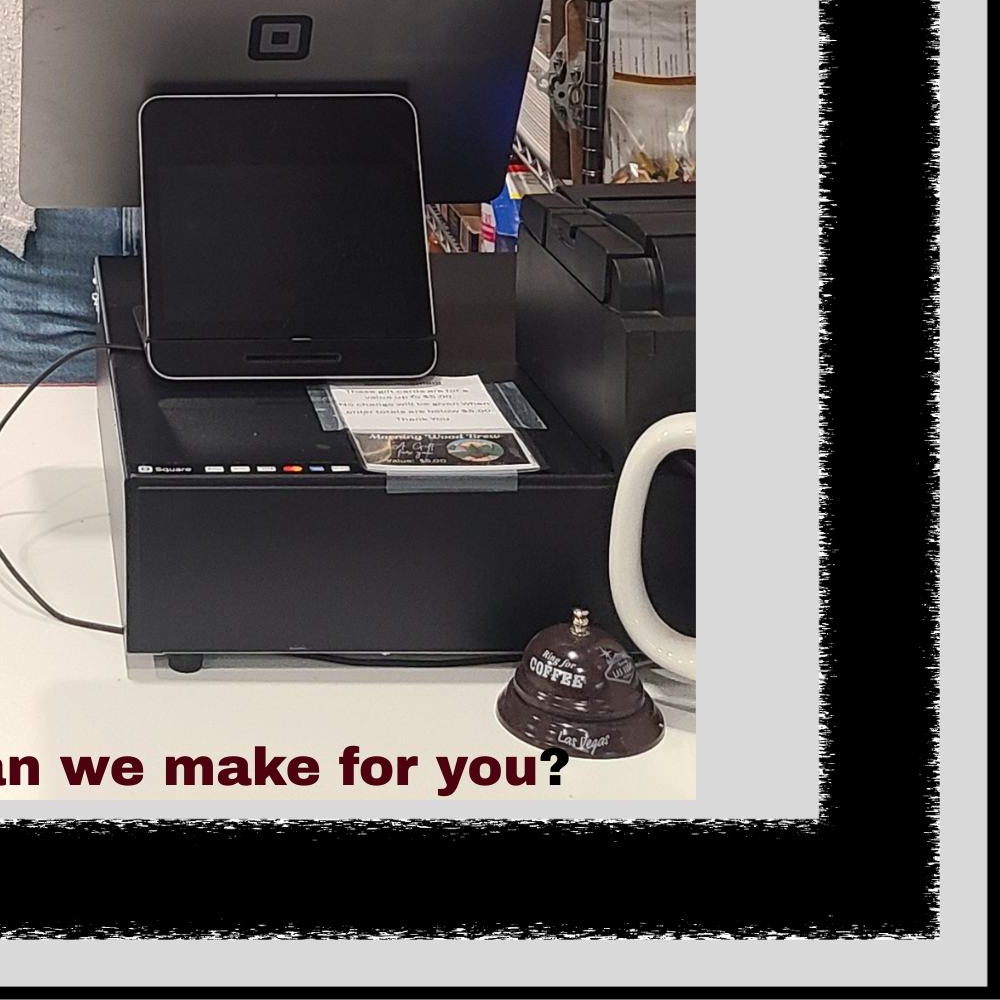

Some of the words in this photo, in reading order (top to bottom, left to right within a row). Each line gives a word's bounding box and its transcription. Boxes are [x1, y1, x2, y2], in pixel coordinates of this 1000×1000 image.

[368, 433, 423, 441] Morning
[541, 649, 561, 669] Ring
[560, 657, 578, 670] for
[529, 656, 588, 690] COFFEE
[557, 730, 577, 748] Las
[578, 733, 611, 756] Vegas
